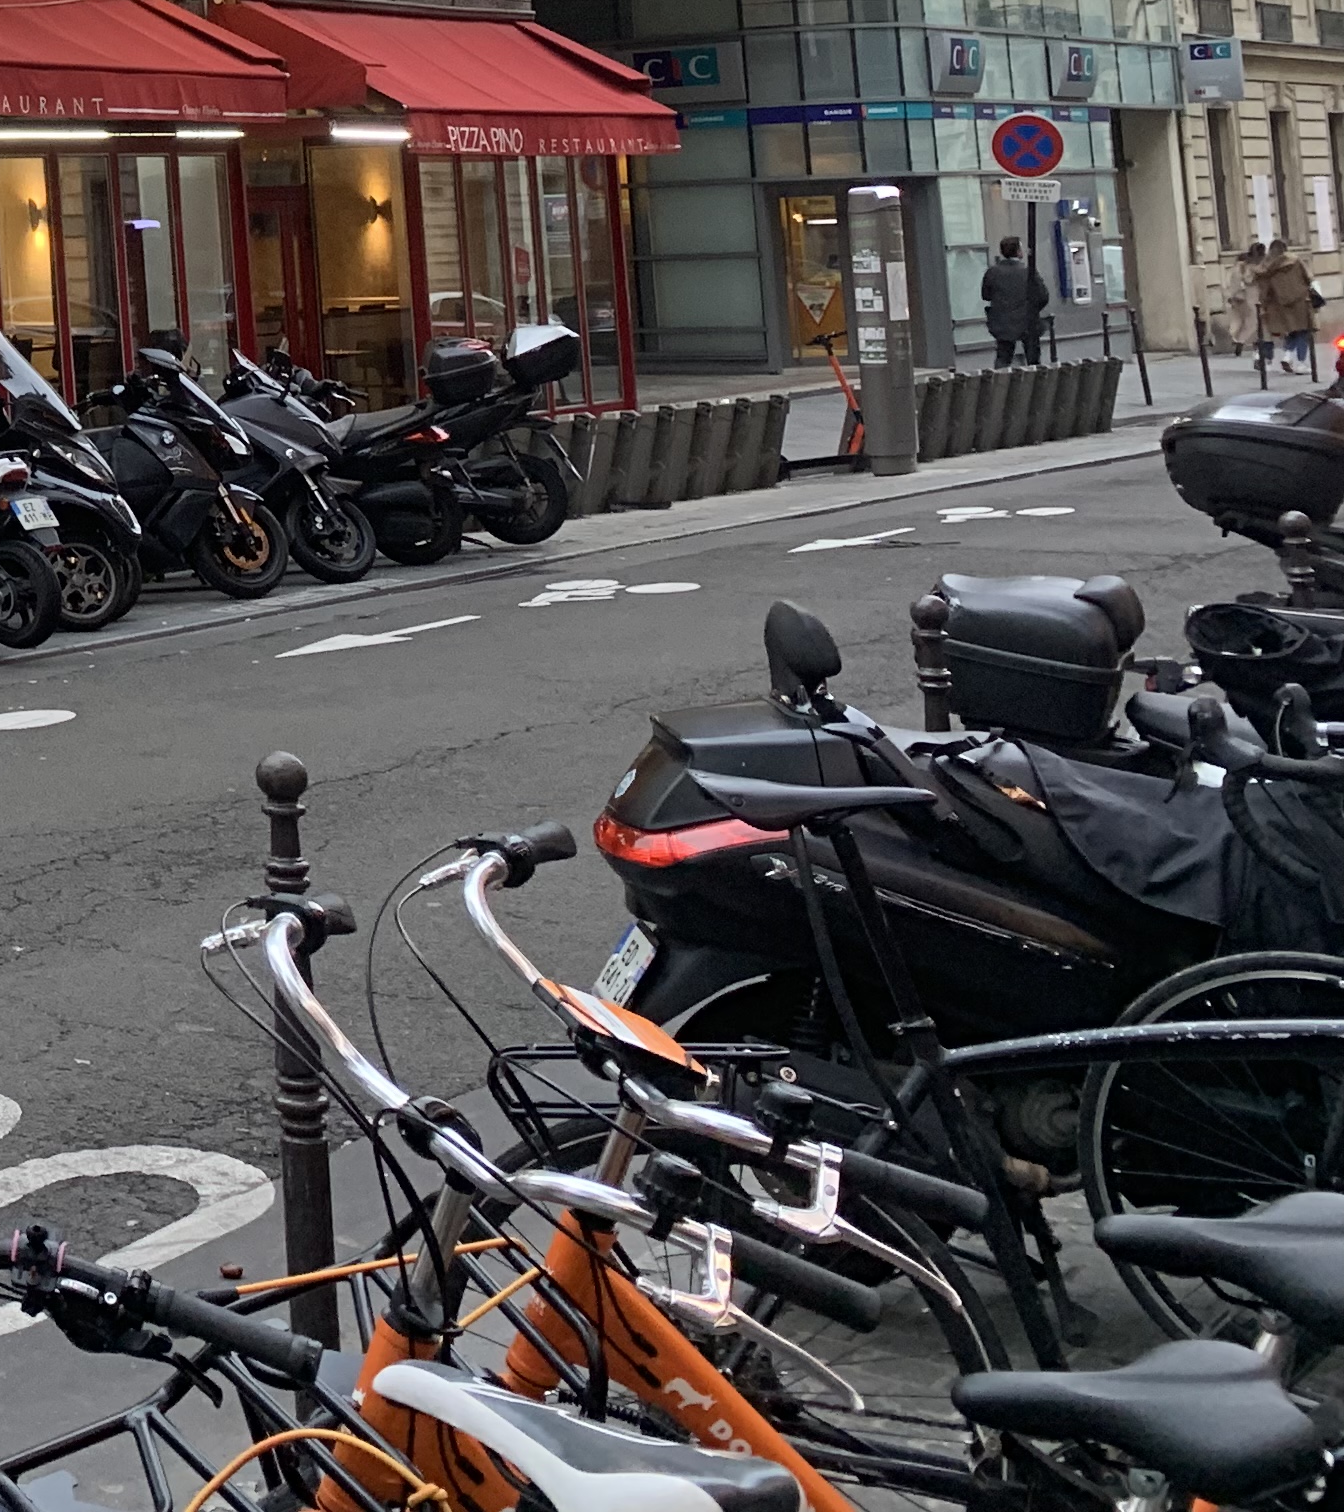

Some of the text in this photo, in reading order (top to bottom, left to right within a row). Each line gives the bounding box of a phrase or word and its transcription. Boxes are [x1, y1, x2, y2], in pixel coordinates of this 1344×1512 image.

[447, 125, 645, 153] PIZZA PINO RESTAURANT
